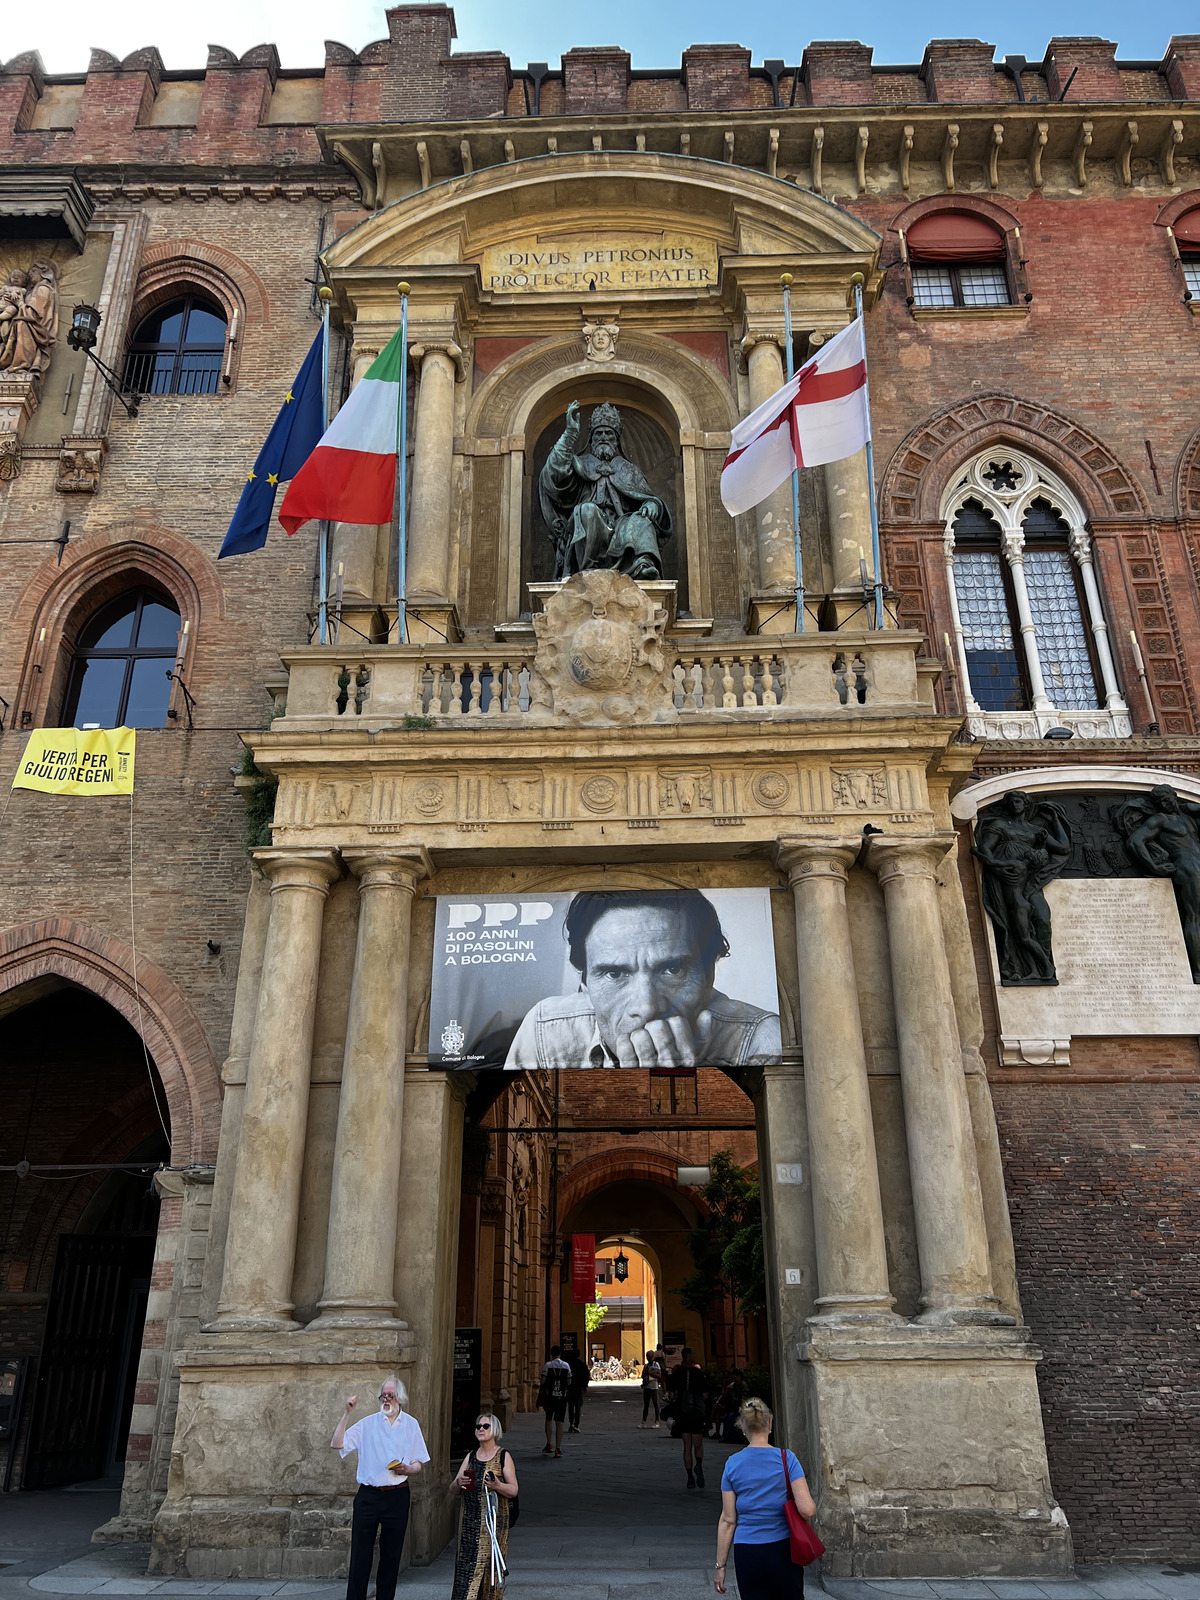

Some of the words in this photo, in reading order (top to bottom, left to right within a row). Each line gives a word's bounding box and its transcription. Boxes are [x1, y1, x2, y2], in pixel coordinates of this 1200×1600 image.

[583, 248, 694, 264] PETRONIUS
[650, 268, 712, 282] PATER
[81, 752, 108, 768] PER
[24, 761, 68, 781] GIULIO
[67, 767, 114, 783] REGENI
[447, 901, 554, 929] PPP
[446, 931, 476, 942] 100
[480, 929, 519, 940] ANNI
[445, 944, 460, 954] DI
[463, 940, 534, 953] PASOLINI
[444, 956, 457, 966] A
[461, 952, 537, 965] BOLOGNA
[789, 1270, 797, 1283] 6
